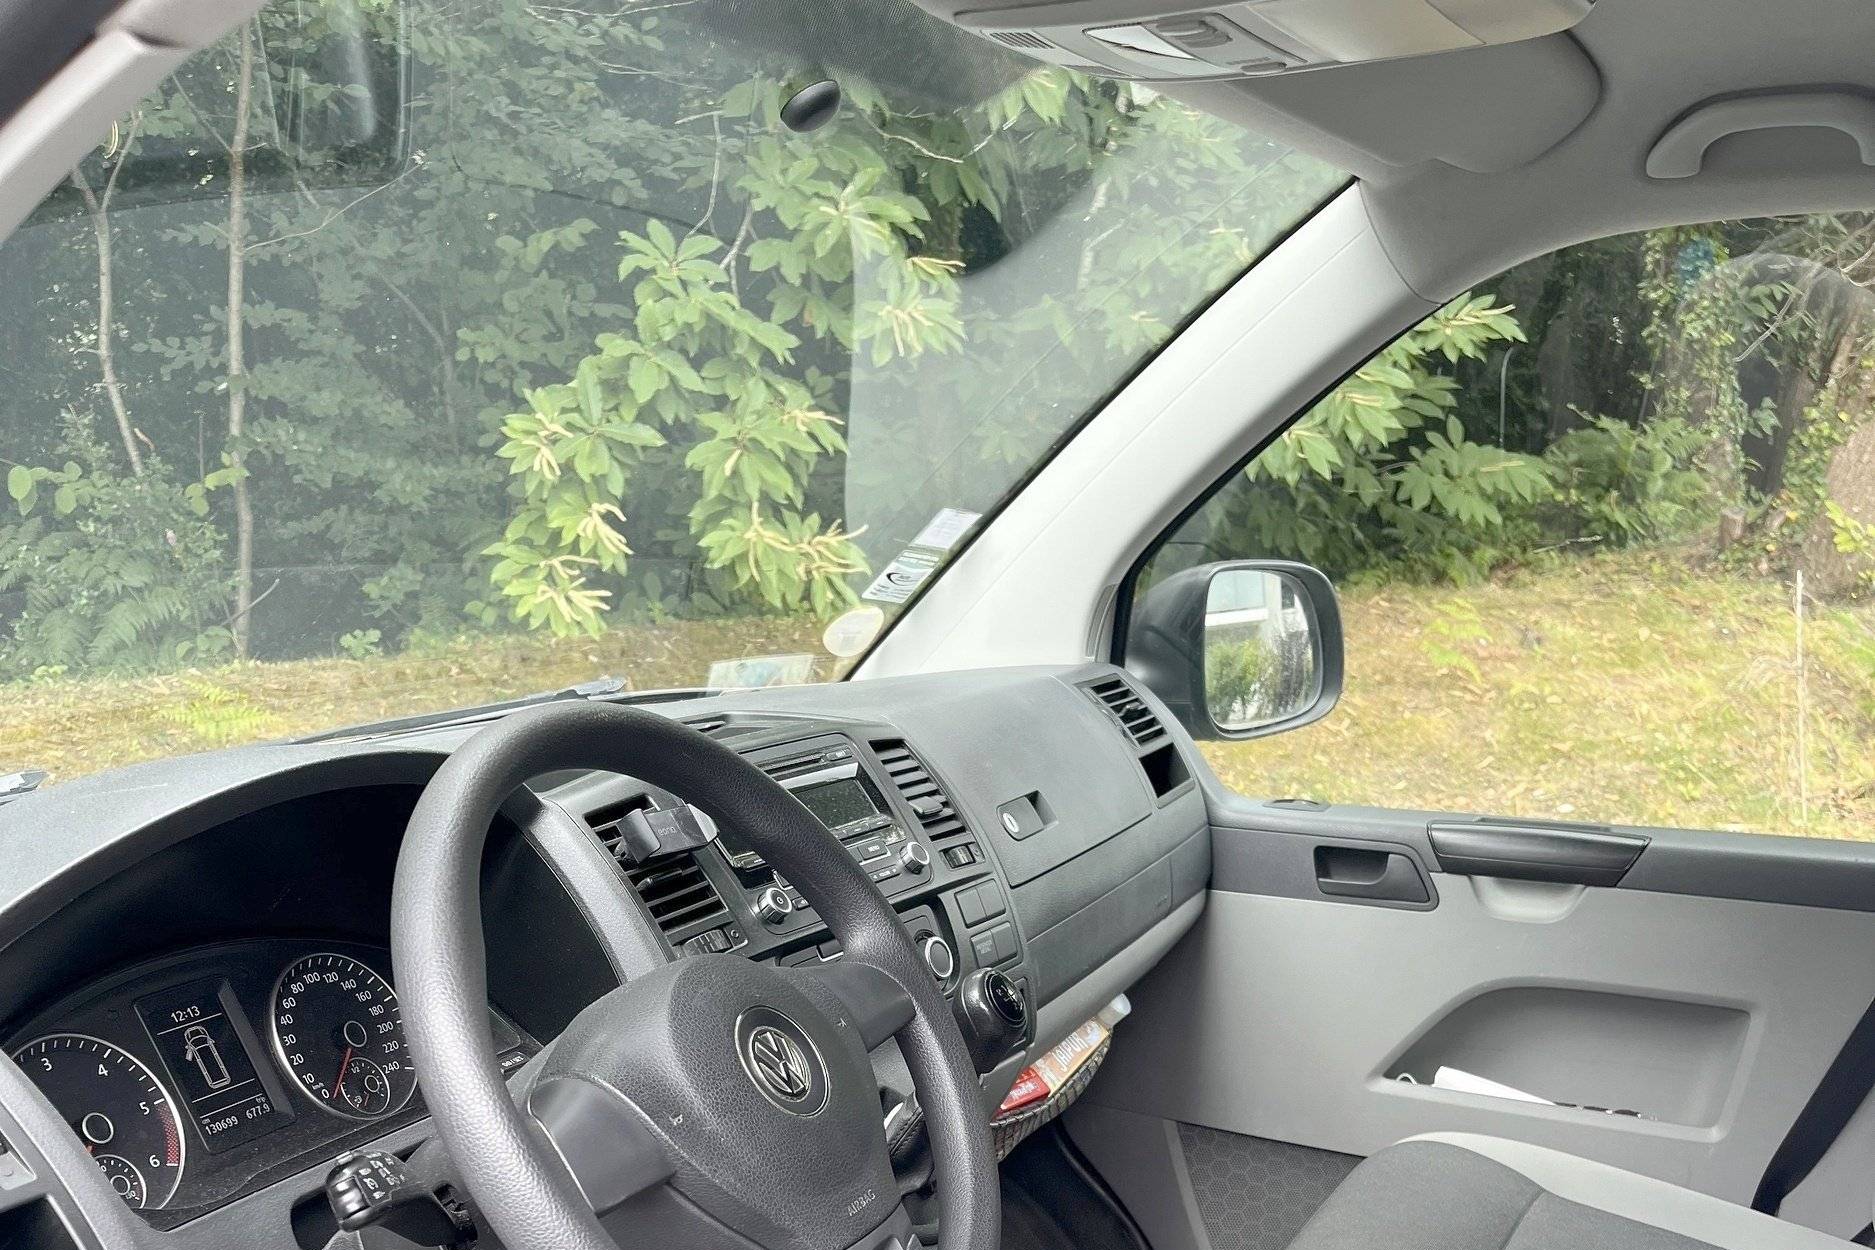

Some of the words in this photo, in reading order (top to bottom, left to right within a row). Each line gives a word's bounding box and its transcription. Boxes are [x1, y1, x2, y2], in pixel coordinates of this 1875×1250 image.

[303, 972, 320, 984] 100
[323, 972, 338, 984] 120
[290, 982, 304, 994] 80
[340, 979, 357, 991] 140
[355, 991, 372, 1002] 160
[282, 997, 296, 1009] 60
[171, 1006, 200, 1023] 12:13
[369, 1004, 384, 1016] 180
[280, 1014, 293, 1026] 40
[377, 1022, 393, 1034] 200
[283, 1034, 296, 1046] 30
[382, 1040, 399, 1053] 220
[41, 1058, 52, 1071] 3
[290, 1053, 304, 1065] 20
[98, 1064, 108, 1076] 4
[383, 1061, 400, 1074] 240
[303, 1073, 314, 1084] 10
[322, 1089, 329, 1098] 0
[139, 1102, 150, 1115] 5
[246, 1103, 270, 1119] 677.9
[206, 1116, 238, 1135] 130699
[150, 1155, 160, 1168] 6
[848, 1189, 876, 1216] AIRBAG
